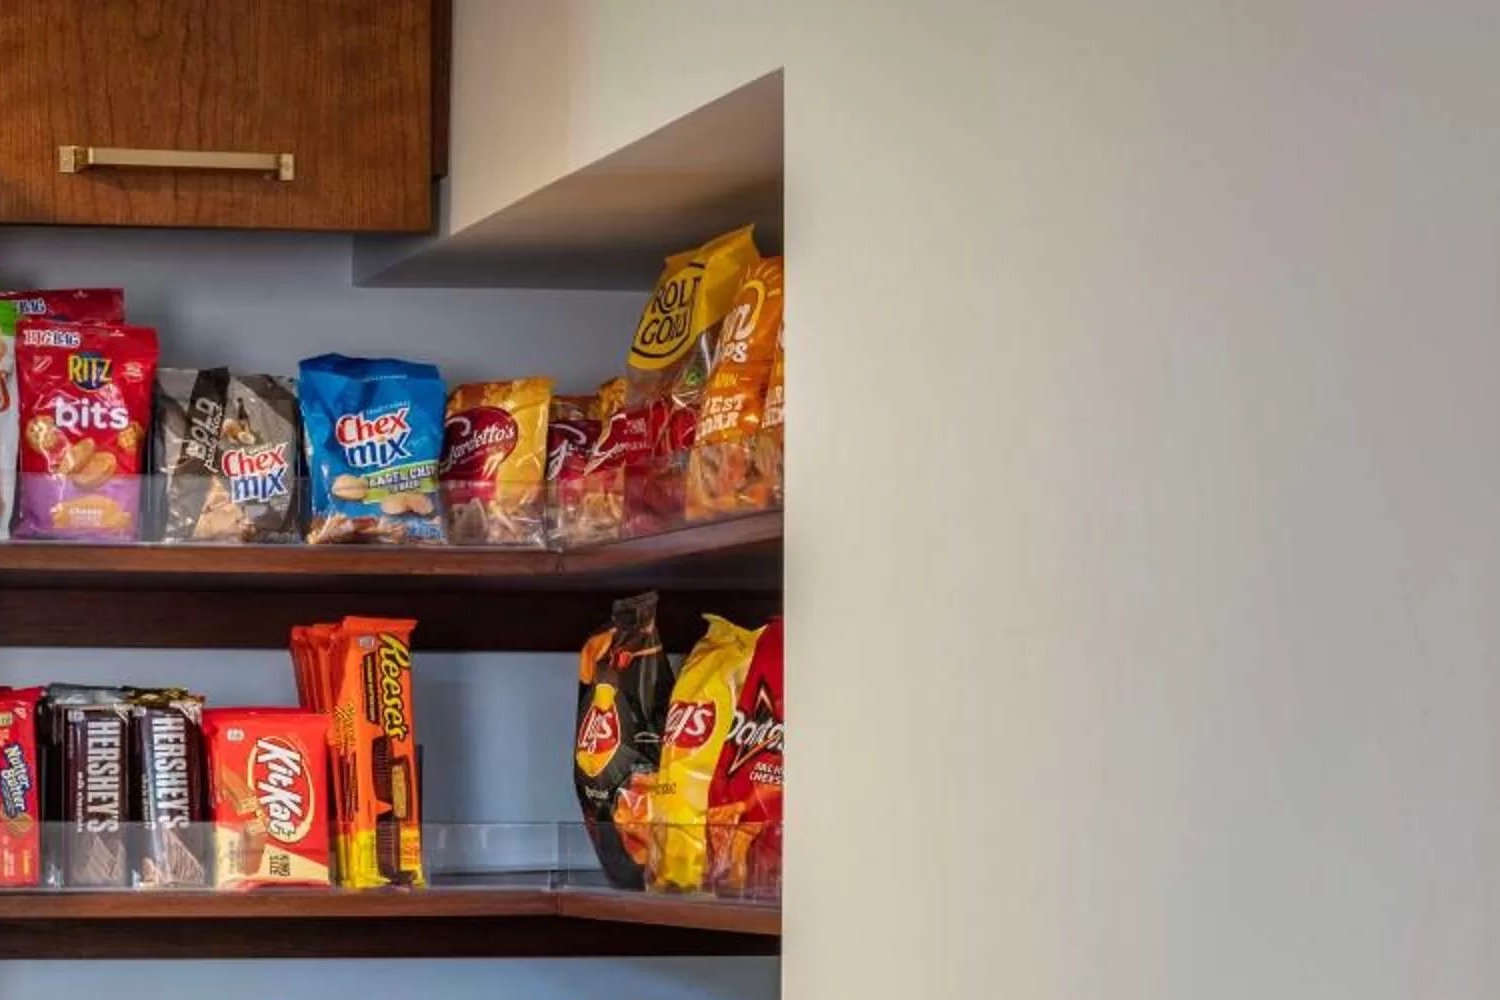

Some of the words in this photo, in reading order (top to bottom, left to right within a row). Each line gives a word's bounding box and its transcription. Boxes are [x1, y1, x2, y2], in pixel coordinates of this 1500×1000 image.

[67, 353, 113, 388] RITZ
[54, 396, 130, 431] bits
[335, 406, 412, 448] Chex
[221, 440, 290, 478] Chex
[87, 718, 121, 833] HERSHEY'S
[152, 715, 191, 830] HERSHEY'S
